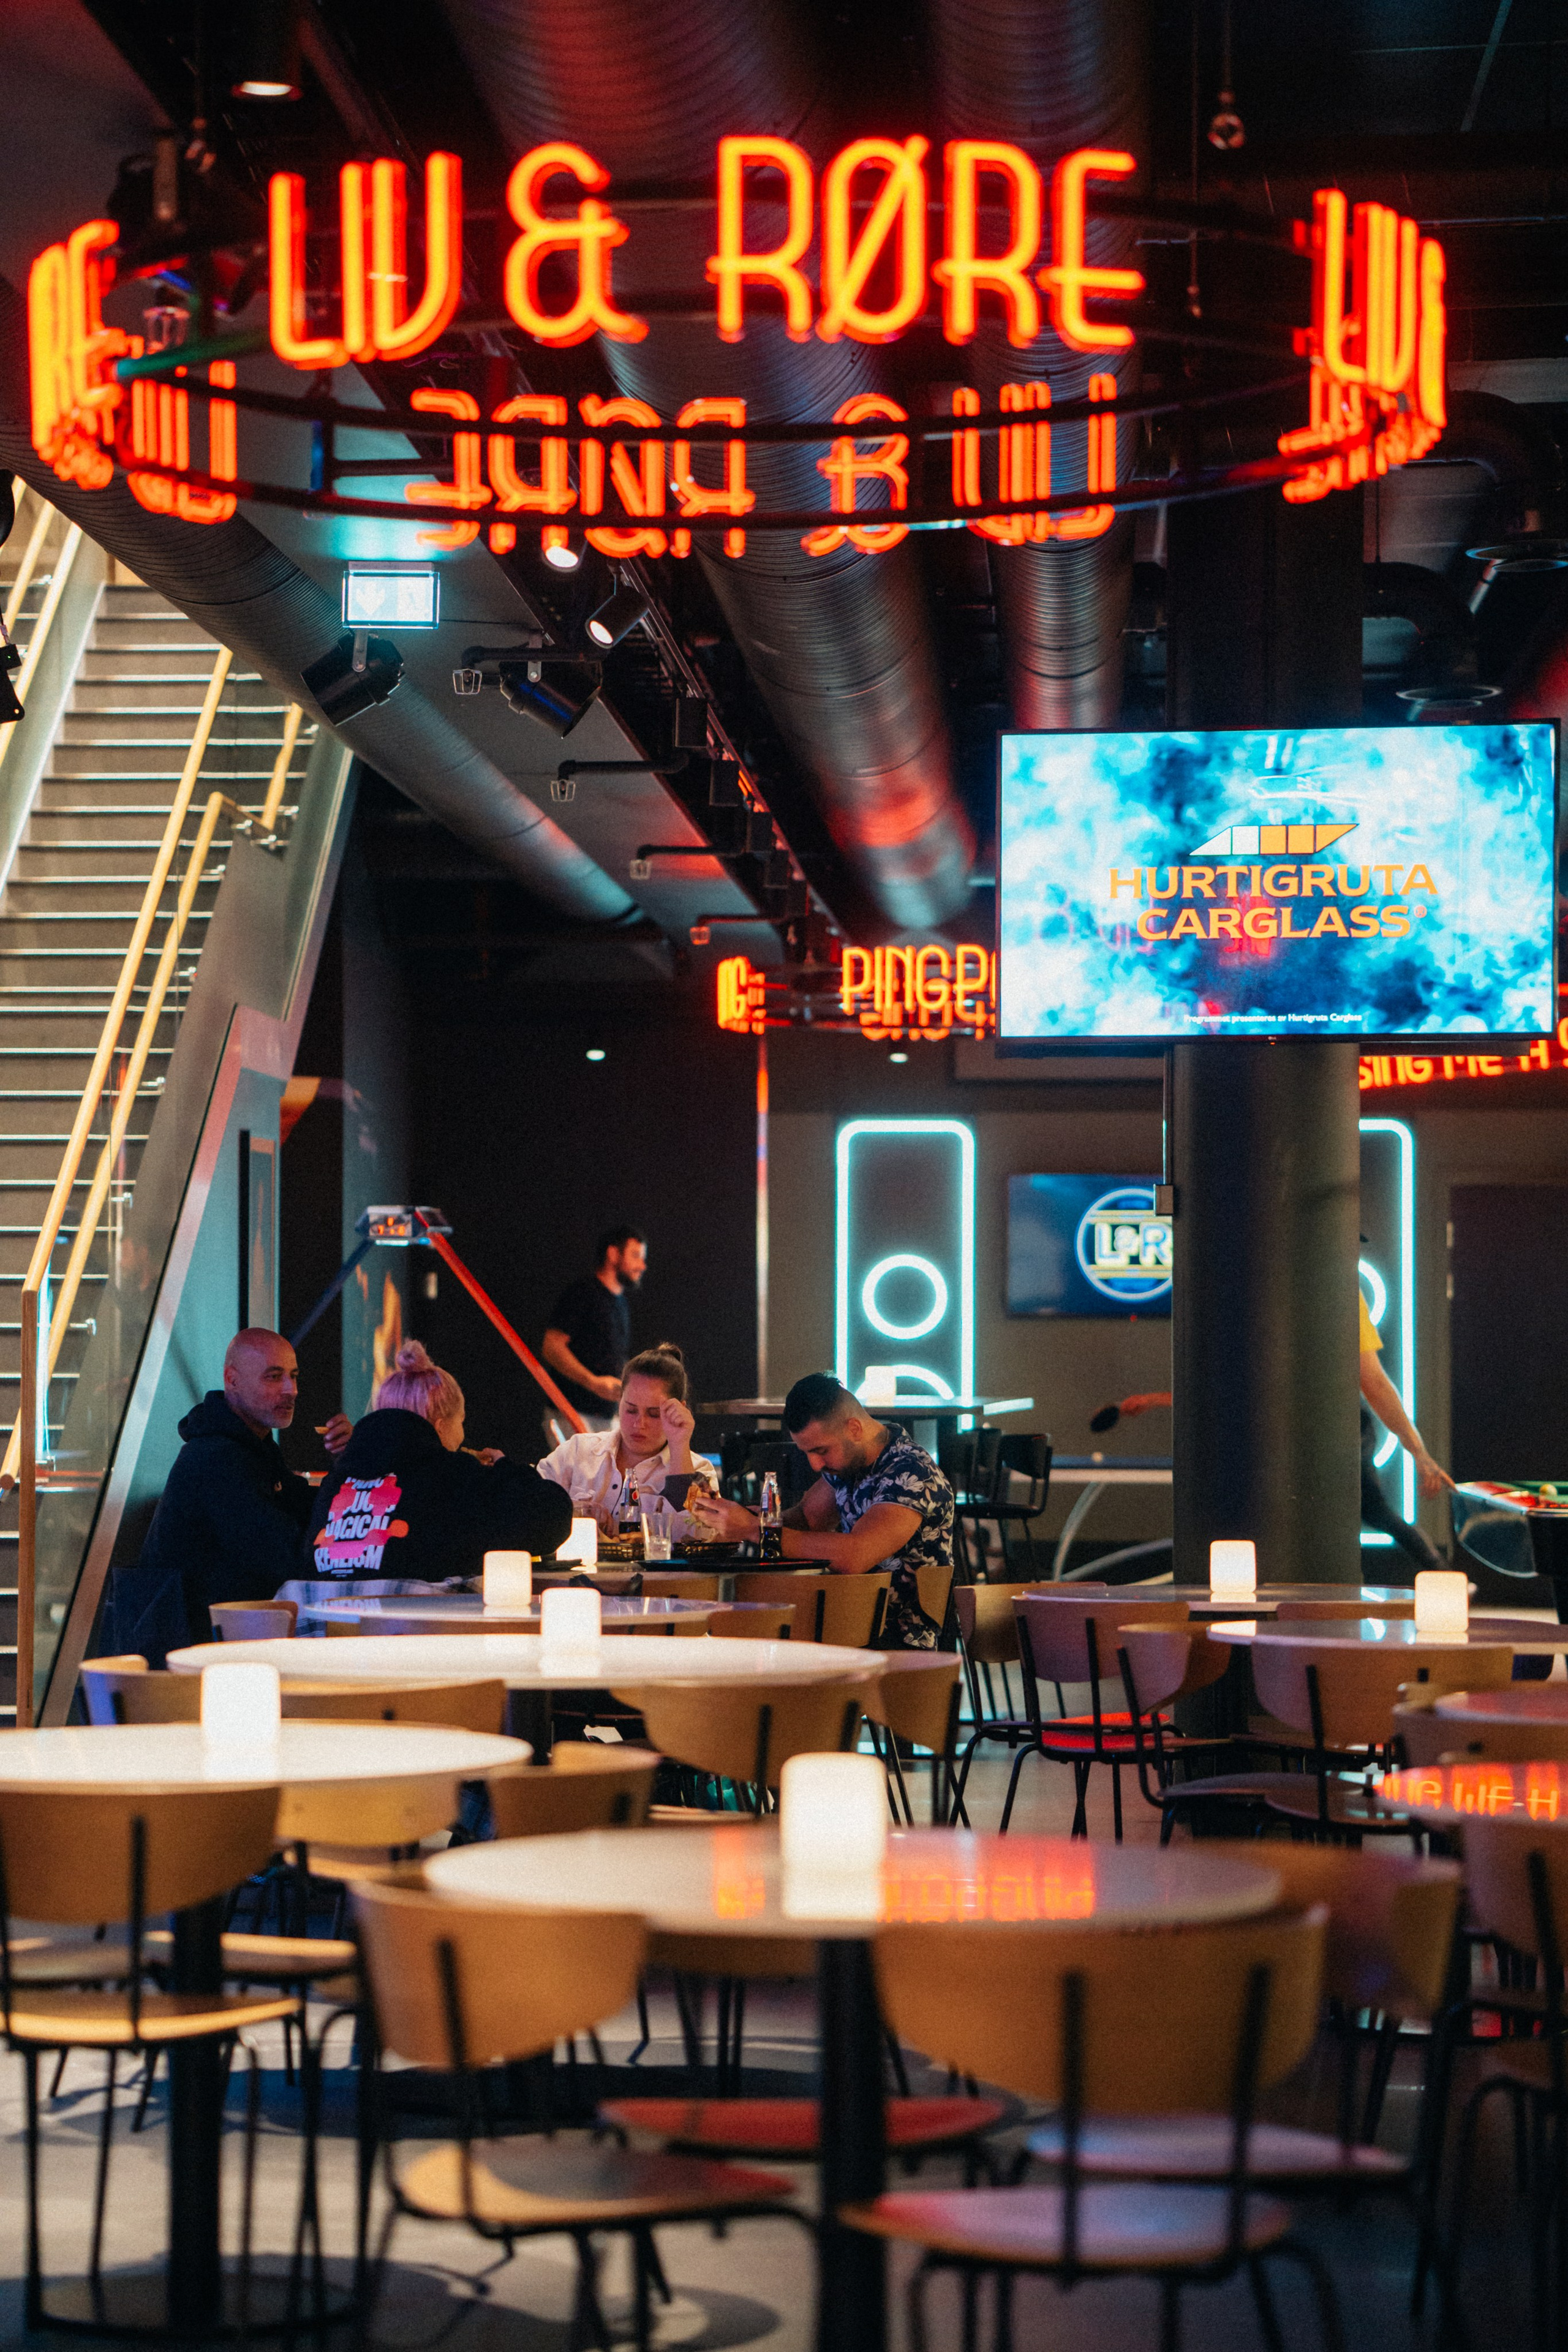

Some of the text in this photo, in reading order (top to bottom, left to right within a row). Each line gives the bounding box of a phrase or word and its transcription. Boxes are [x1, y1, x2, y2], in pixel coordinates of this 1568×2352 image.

[503, 142, 648, 348] &
[706, 135, 1145, 354] RØRE
[1109, 864, 1438, 899] HURTIGRUTA
[1288, 1014, 1328, 1023] Hurtigruta
[1330, 1013, 1362, 1023] Carglass
